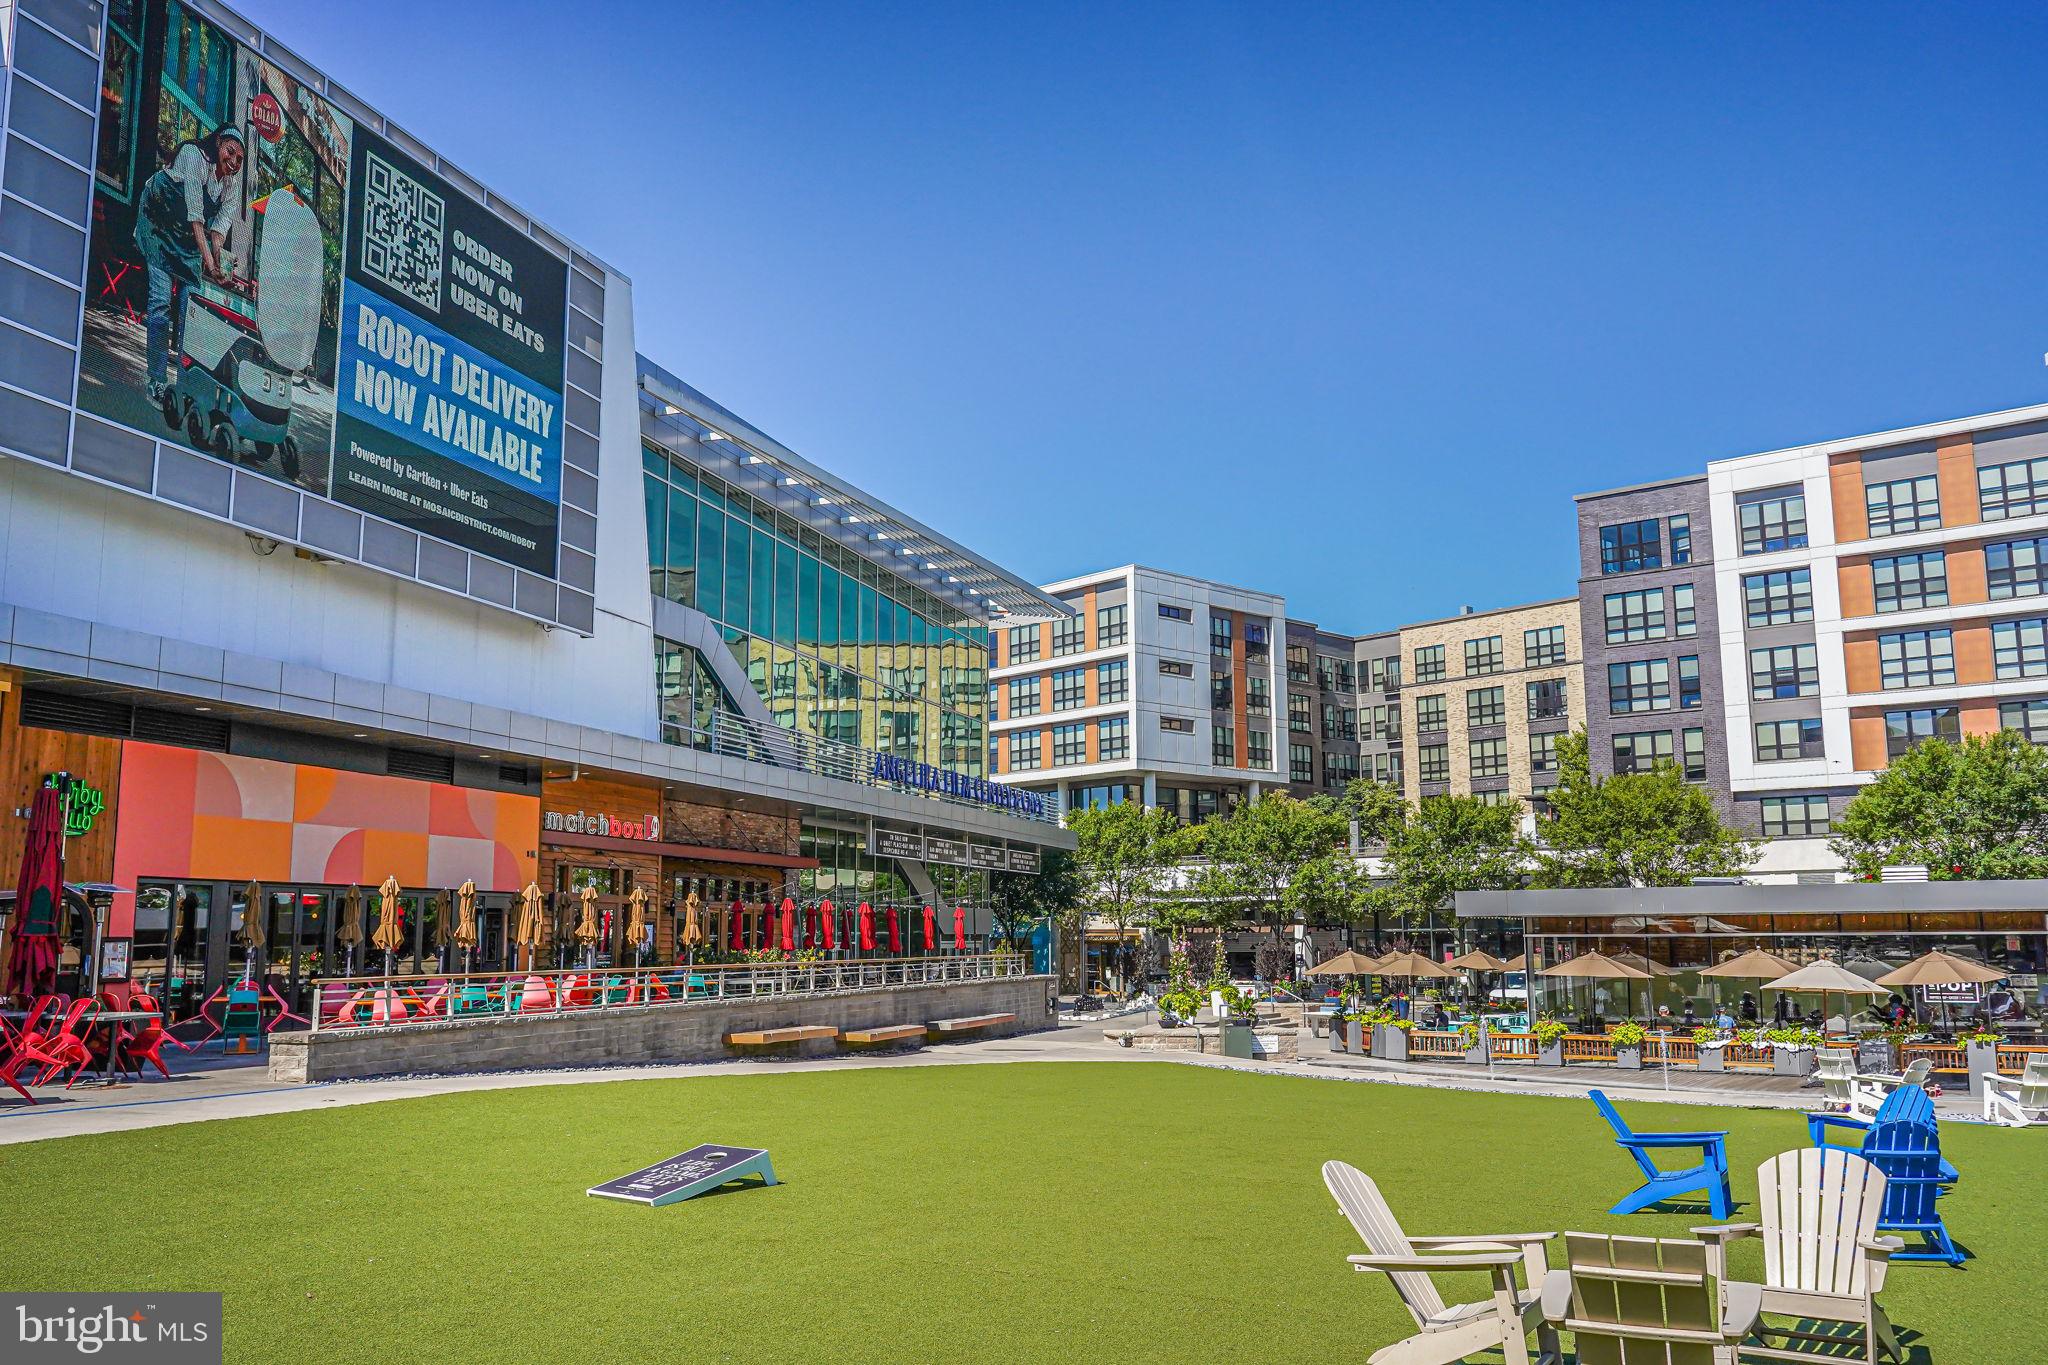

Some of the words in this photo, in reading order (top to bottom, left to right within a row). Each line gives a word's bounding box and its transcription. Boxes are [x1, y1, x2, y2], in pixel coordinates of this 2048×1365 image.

[451, 255, 495, 297] NOW
[498, 286, 522, 314] ON
[453, 230, 513, 283] ORDER
[450, 282, 499, 328] UBER
[502, 313, 545, 352] EATS
[357, 304, 445, 385] ROBOT
[451, 353, 554, 439] DELIVERY
[354, 359, 417, 425] NOW
[422, 394, 543, 484] AVAILABLE
[350, 441, 391, 470] Powered
[393, 458, 404, 478] by
[406, 464, 441, 491] Cartken
[442, 482, 448, 491] +
[450, 482, 470, 501] Uber
[471, 491, 489, 509] Eats
[348, 471, 381, 492] LEARN
[382, 483, 409, 502] MORE
[409, 495, 422, 506] AT
[423, 500, 537, 551] MOSAICDISTRICT.COM/ROBOT
[544, 810, 644, 840] matchbox
